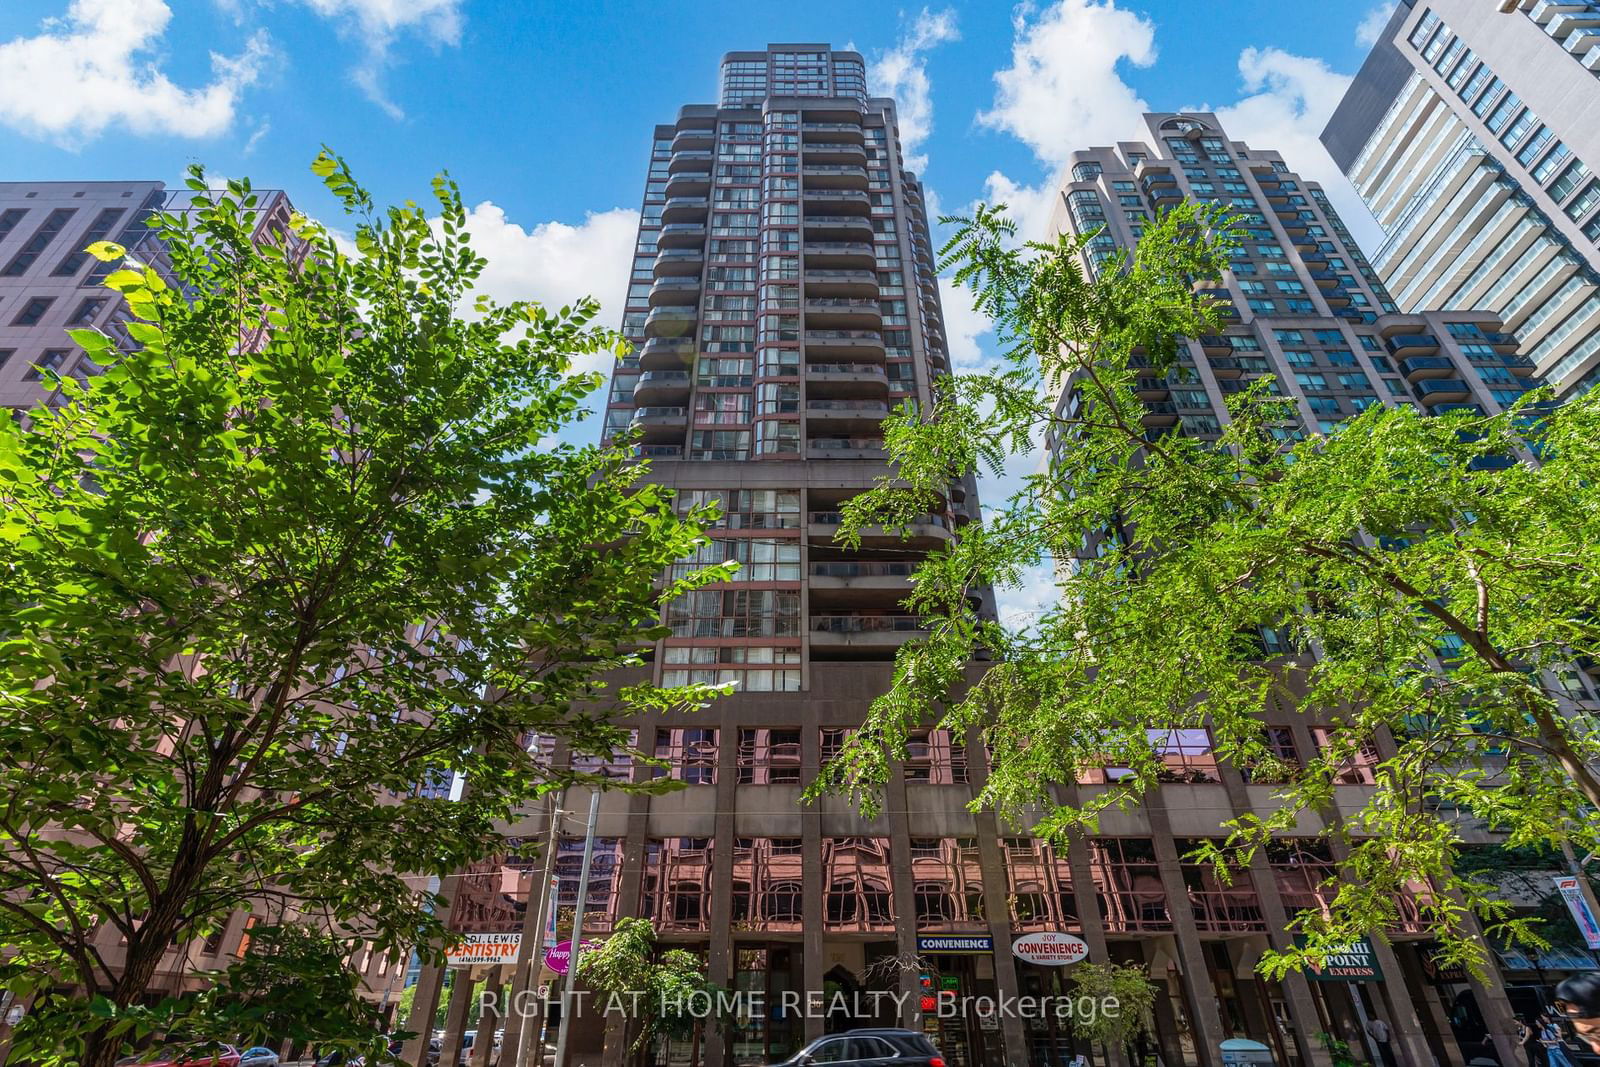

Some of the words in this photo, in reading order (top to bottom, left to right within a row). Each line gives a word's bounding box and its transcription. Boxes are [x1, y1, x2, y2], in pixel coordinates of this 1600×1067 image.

[1041, 934, 1057, 942] JOY
[921, 939, 989, 949] CONVENIENCE
[1017, 943, 1084, 954] CONVENIENCE
[444, 944, 519, 957] DENTISTRY
[1326, 954, 1370, 967] POINT
[1329, 967, 1375, 976] EXPRESS
